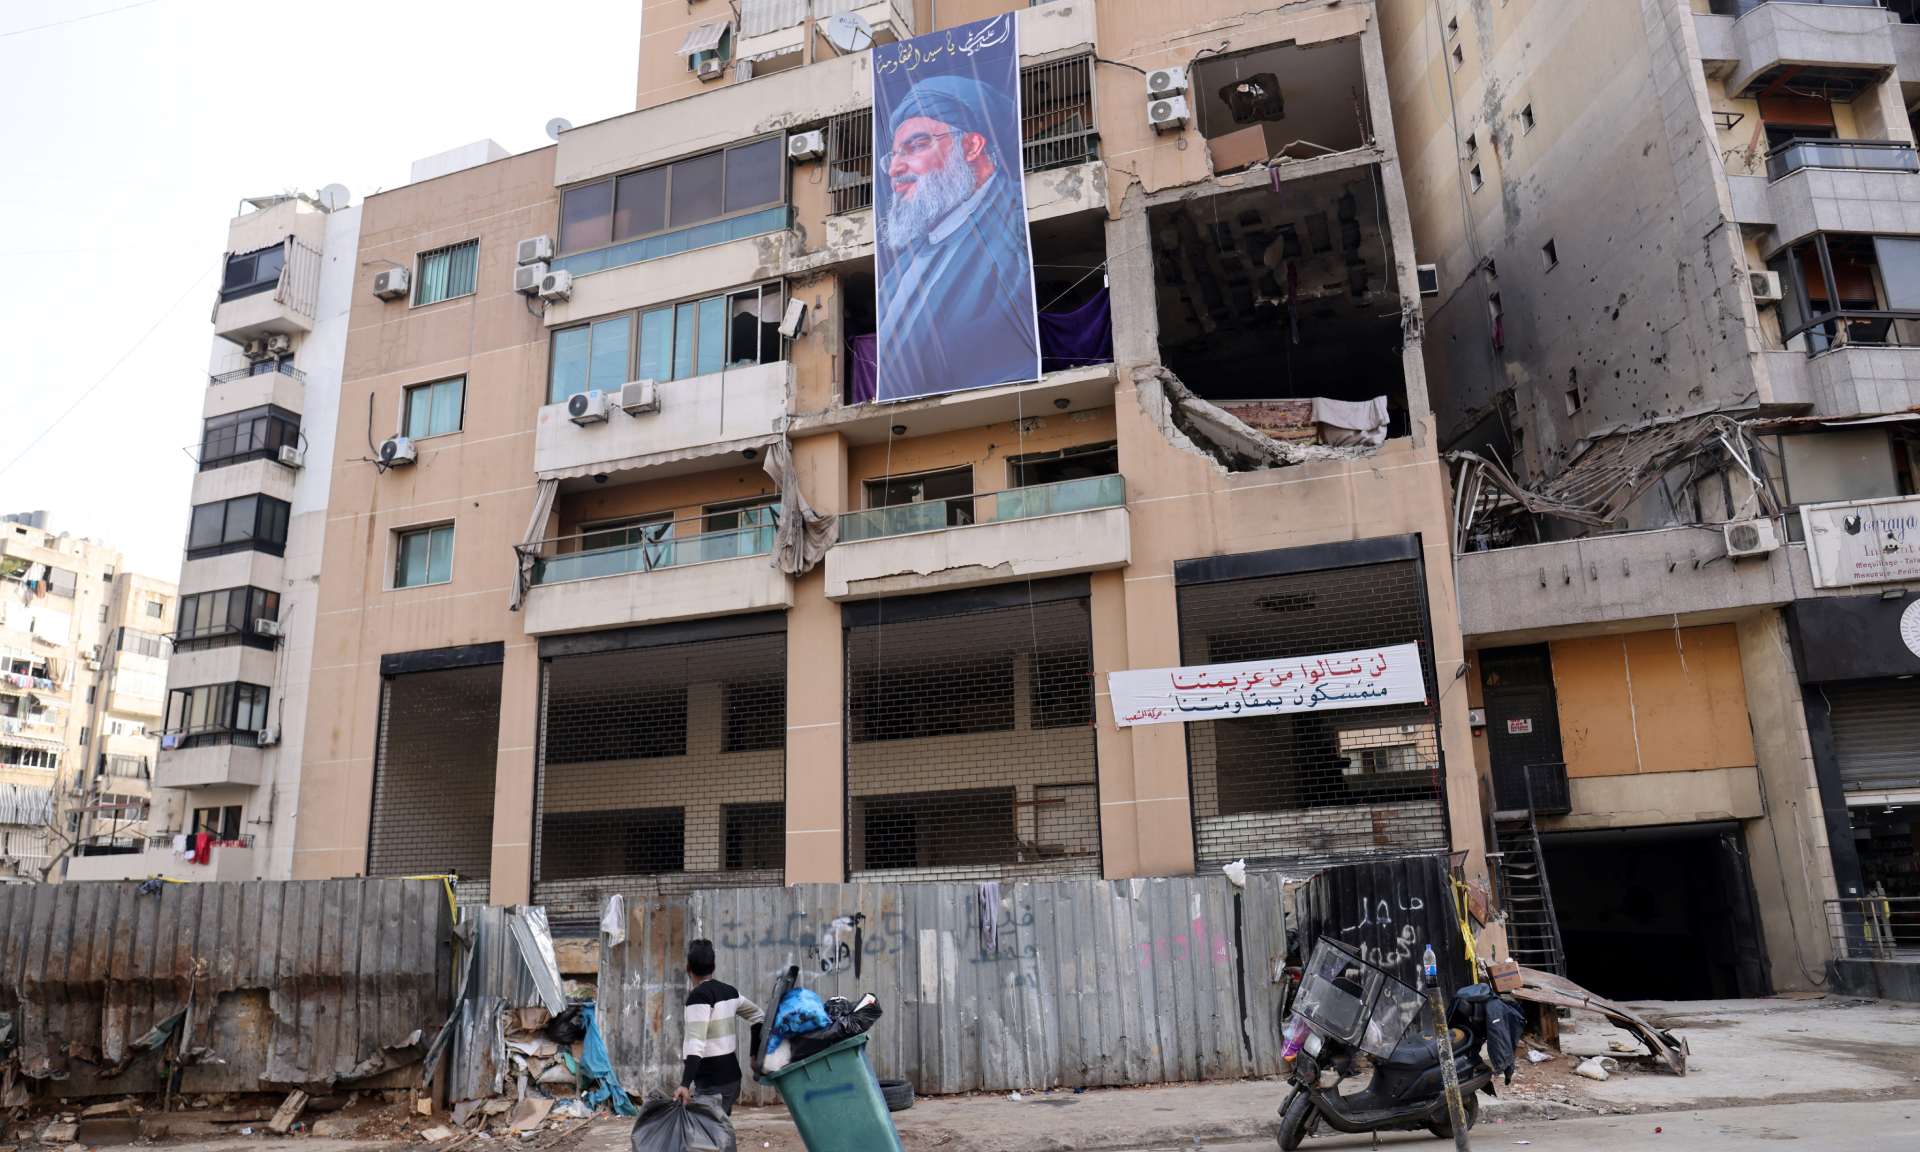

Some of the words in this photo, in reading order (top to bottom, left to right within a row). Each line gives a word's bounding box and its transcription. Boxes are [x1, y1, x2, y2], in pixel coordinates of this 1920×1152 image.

[923, 46, 943, 63] سيد
[945, 30, 956, 56] يا
[876, 43, 921, 75] المقاومة
[1300, 658, 1362, 684] تنالوا
[1369, 652, 1387, 677] لن
[1171, 672, 1265, 691] عزيمتنا
[1269, 668, 1293, 687] من
